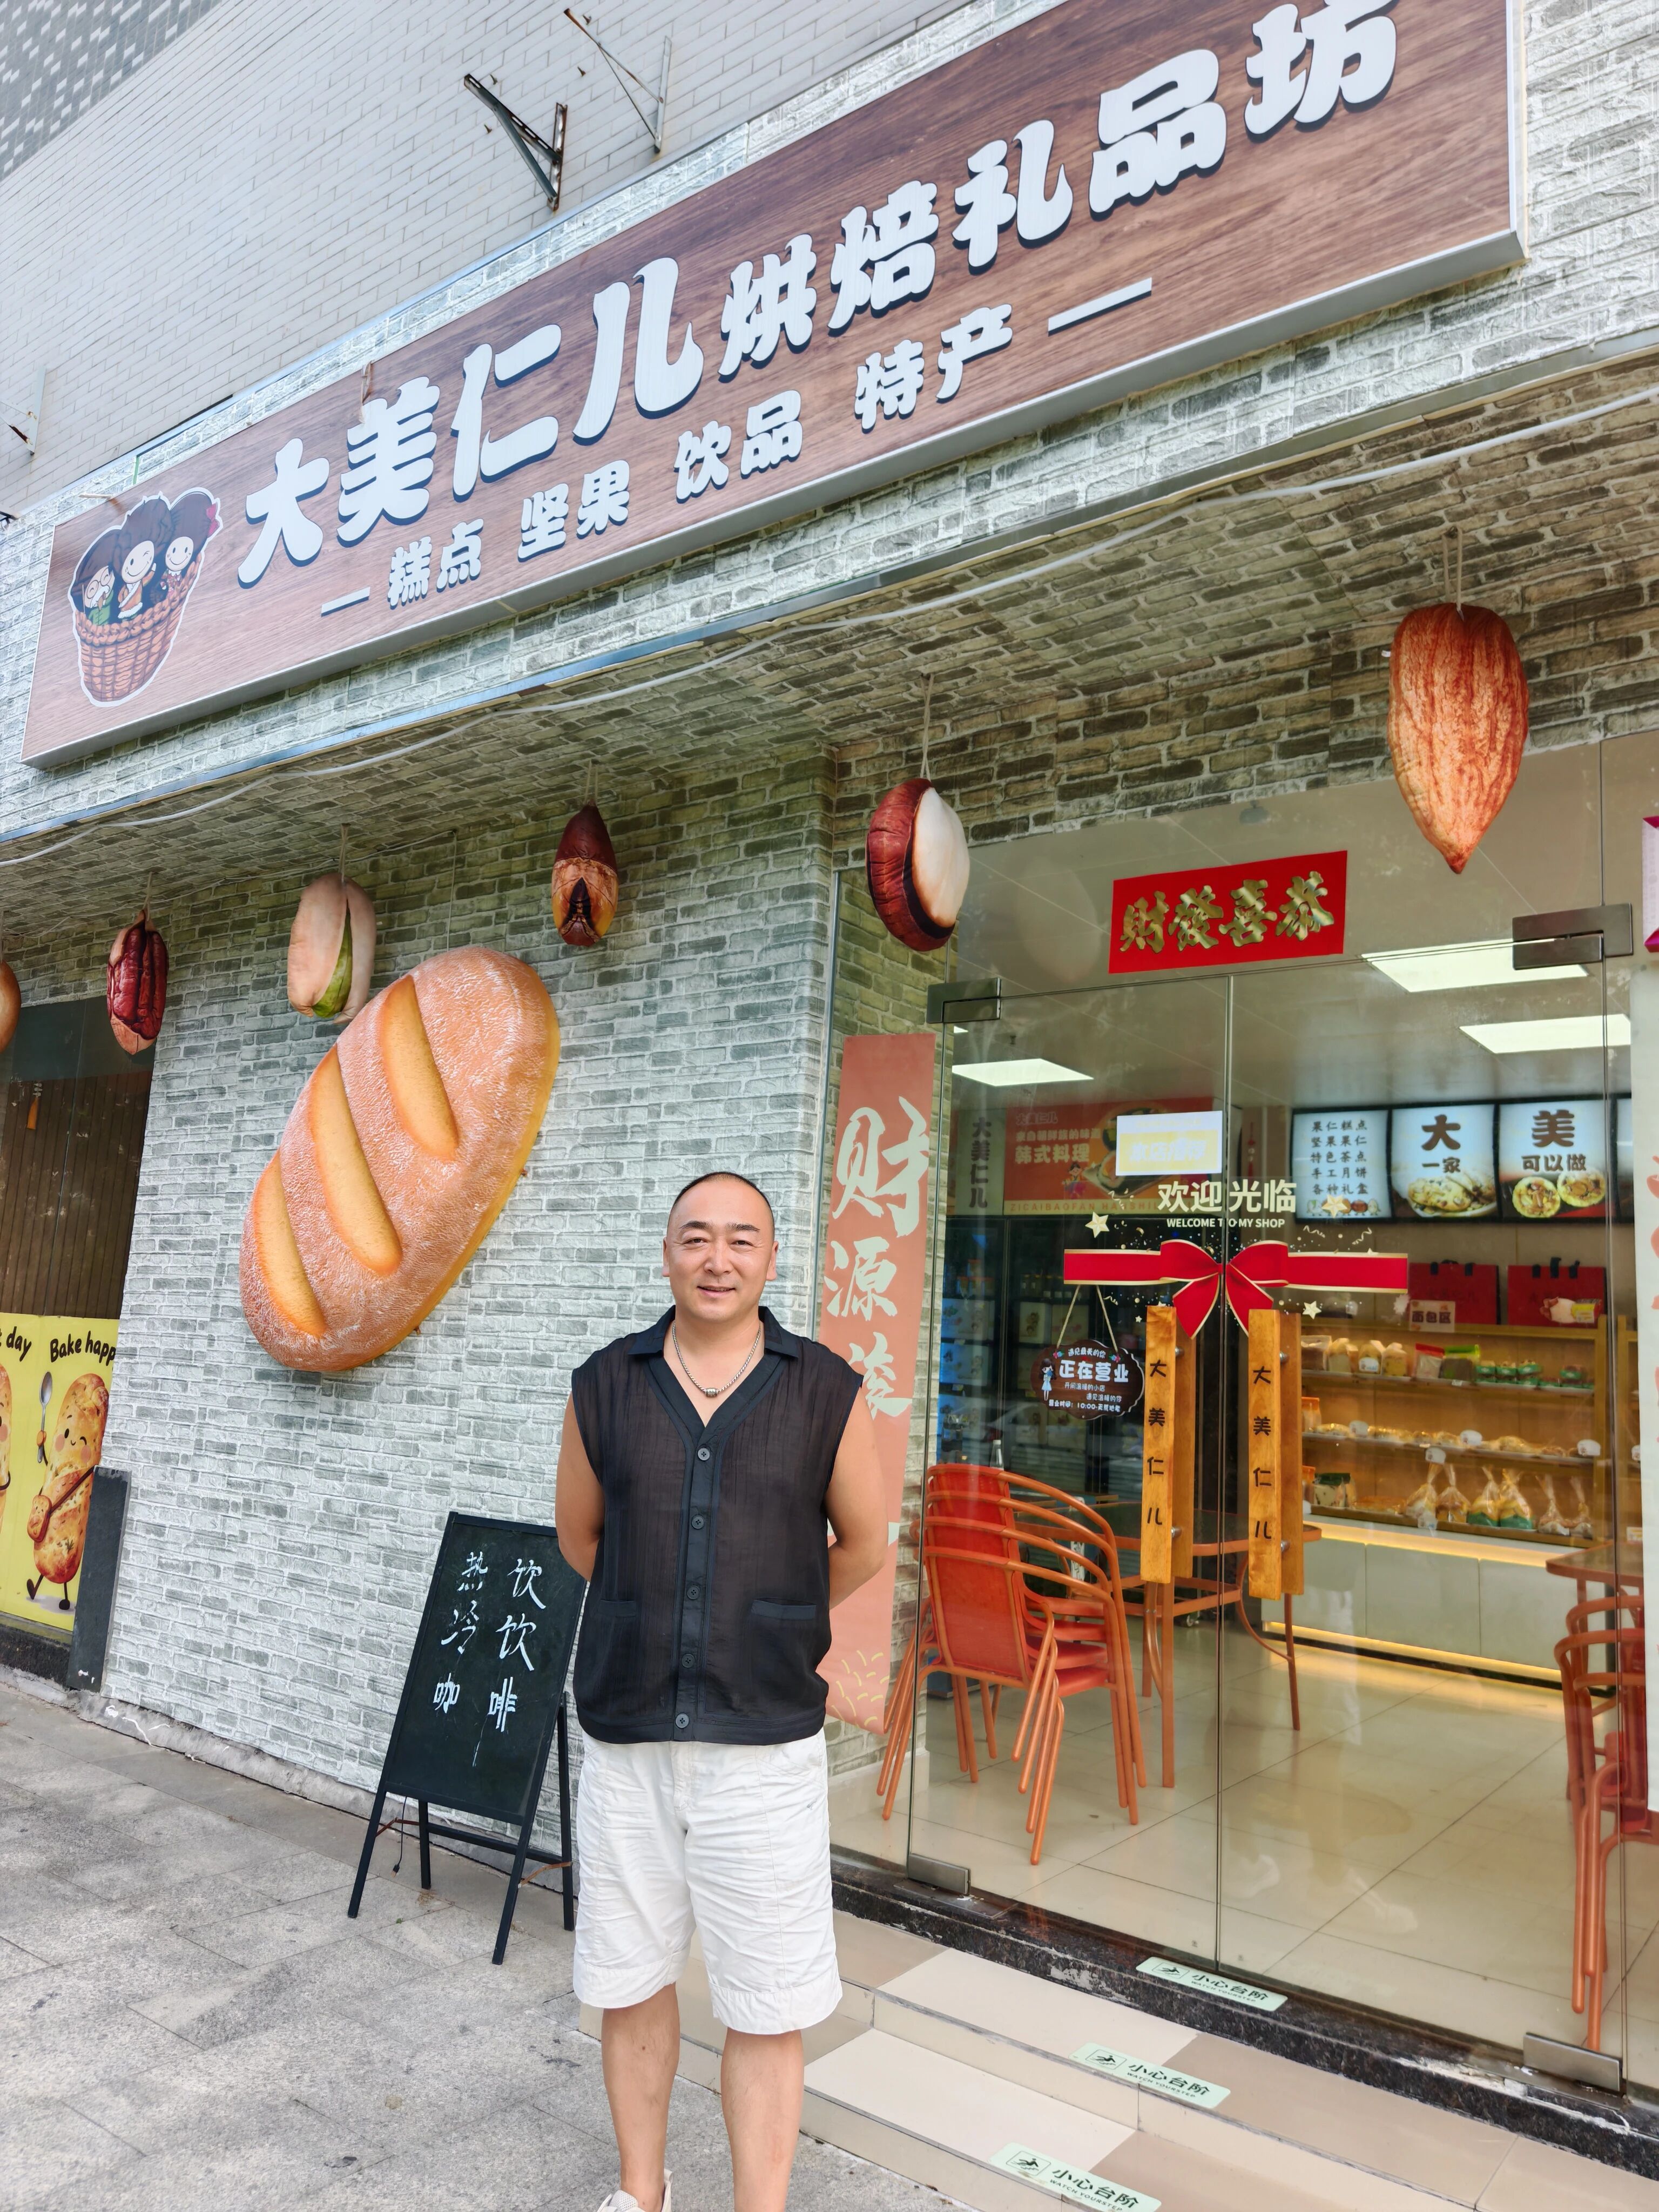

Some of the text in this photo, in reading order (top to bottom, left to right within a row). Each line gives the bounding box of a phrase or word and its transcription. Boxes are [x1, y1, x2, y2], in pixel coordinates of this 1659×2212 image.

[238, 0, 1397, 589] 大美仁儿烘焙礼品坊
[386, 303, 1013, 609] 糕点 坚果 饮品 特产
[1311, 1120, 1367, 1132] 果仁糕点
[1311, 1135, 1367, 1148] 坚果果仁
[1421, 1114, 1461, 1151] 大
[1532, 1109, 1575, 1148] 美
[969, 1117, 992, 1208] 大美仁儿
[1015, 1143, 1090, 1164] 韩式料理
[1310, 1151, 1367, 1164] 特色茶点
[1421, 1157, 1461, 1174] 一家
[1521, 1154, 1587, 1173] 可以做
[1311, 1166, 1367, 1179] 手工月饼
[1311, 1182, 1369, 1196] 各种礼盒
[1010, 1202, 1096, 1212] ZICAIBAOFAN
[1157, 1179, 1297, 1213] 欢迎光临
[1166, 1218, 1285, 1228] WELCOME TO MY SHOP
[824, 1096, 929, 1547] 财源滚
[6, 1326, 32, 1362] day
[50, 1330, 116, 1367] Bake happ
[1059, 1359, 1129, 1382] 正在营业
[1147, 1359, 1168, 1526] 大美仁儿
[1253, 1365, 1272, 1540] 大美仁儿
[456, 1551, 547, 1609] 热饮
[441, 1600, 537, 1671] 冷饮
[433, 1673, 518, 1732] 咖啡
[1191, 1980, 1216, 1991] WATCH
[1191, 1974, 1269, 2001] 小心台阶
[1127, 2072, 1154, 2083] WATCH
[1128, 2063, 1210, 2096] 小心台阶
[1049, 2178, 1077, 2194] WATCH
[1052, 2169, 1139, 2209] 小心台阶
